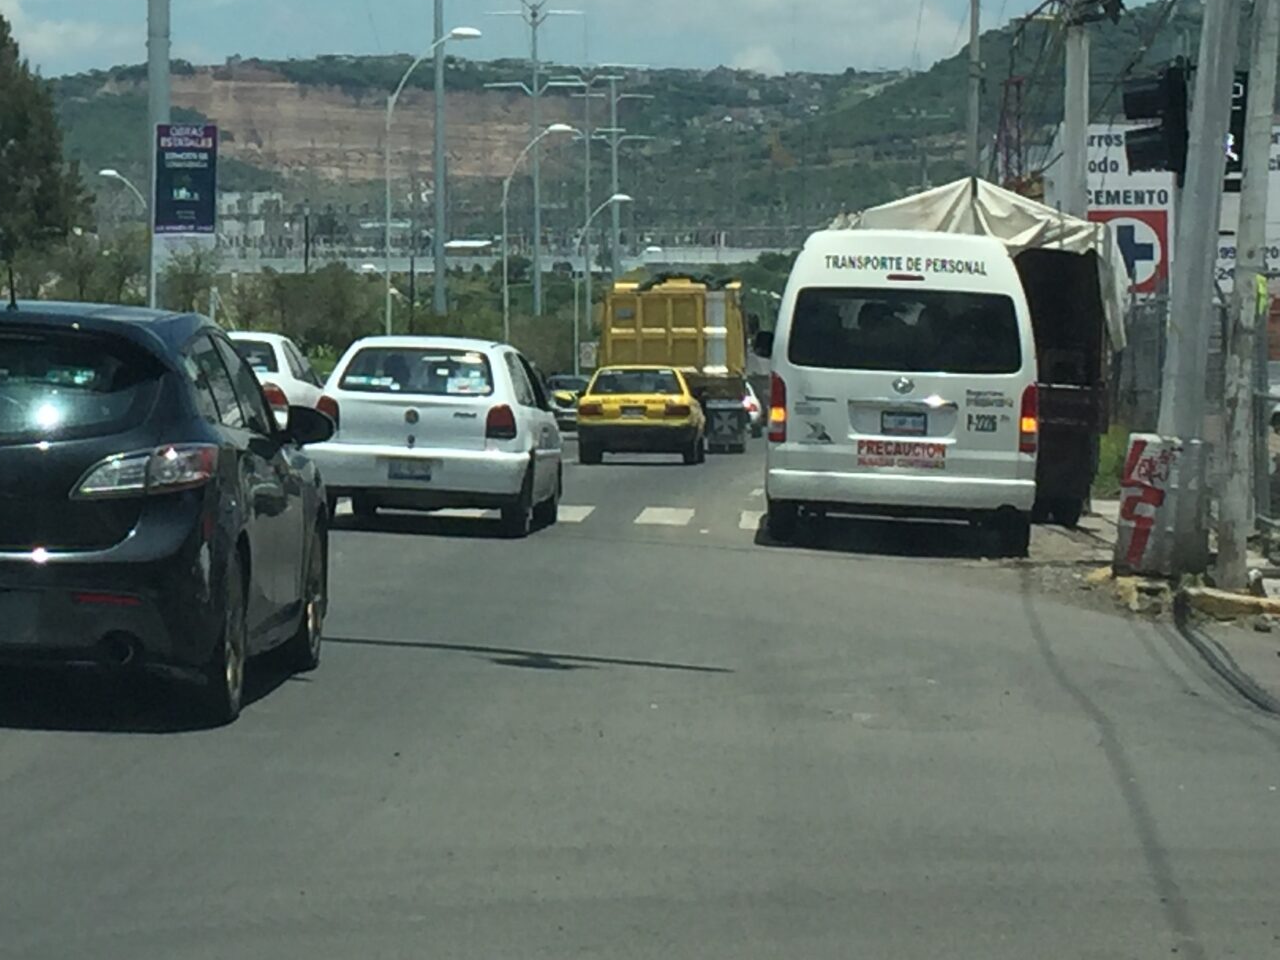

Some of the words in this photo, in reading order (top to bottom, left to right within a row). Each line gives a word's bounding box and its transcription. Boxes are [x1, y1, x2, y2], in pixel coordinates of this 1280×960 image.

[1088, 156, 1119, 173] odo
[825, 255, 902, 271] TRANSPORTE
[906, 257, 921, 272] DE
[925, 258, 988, 276] PERSONAL
